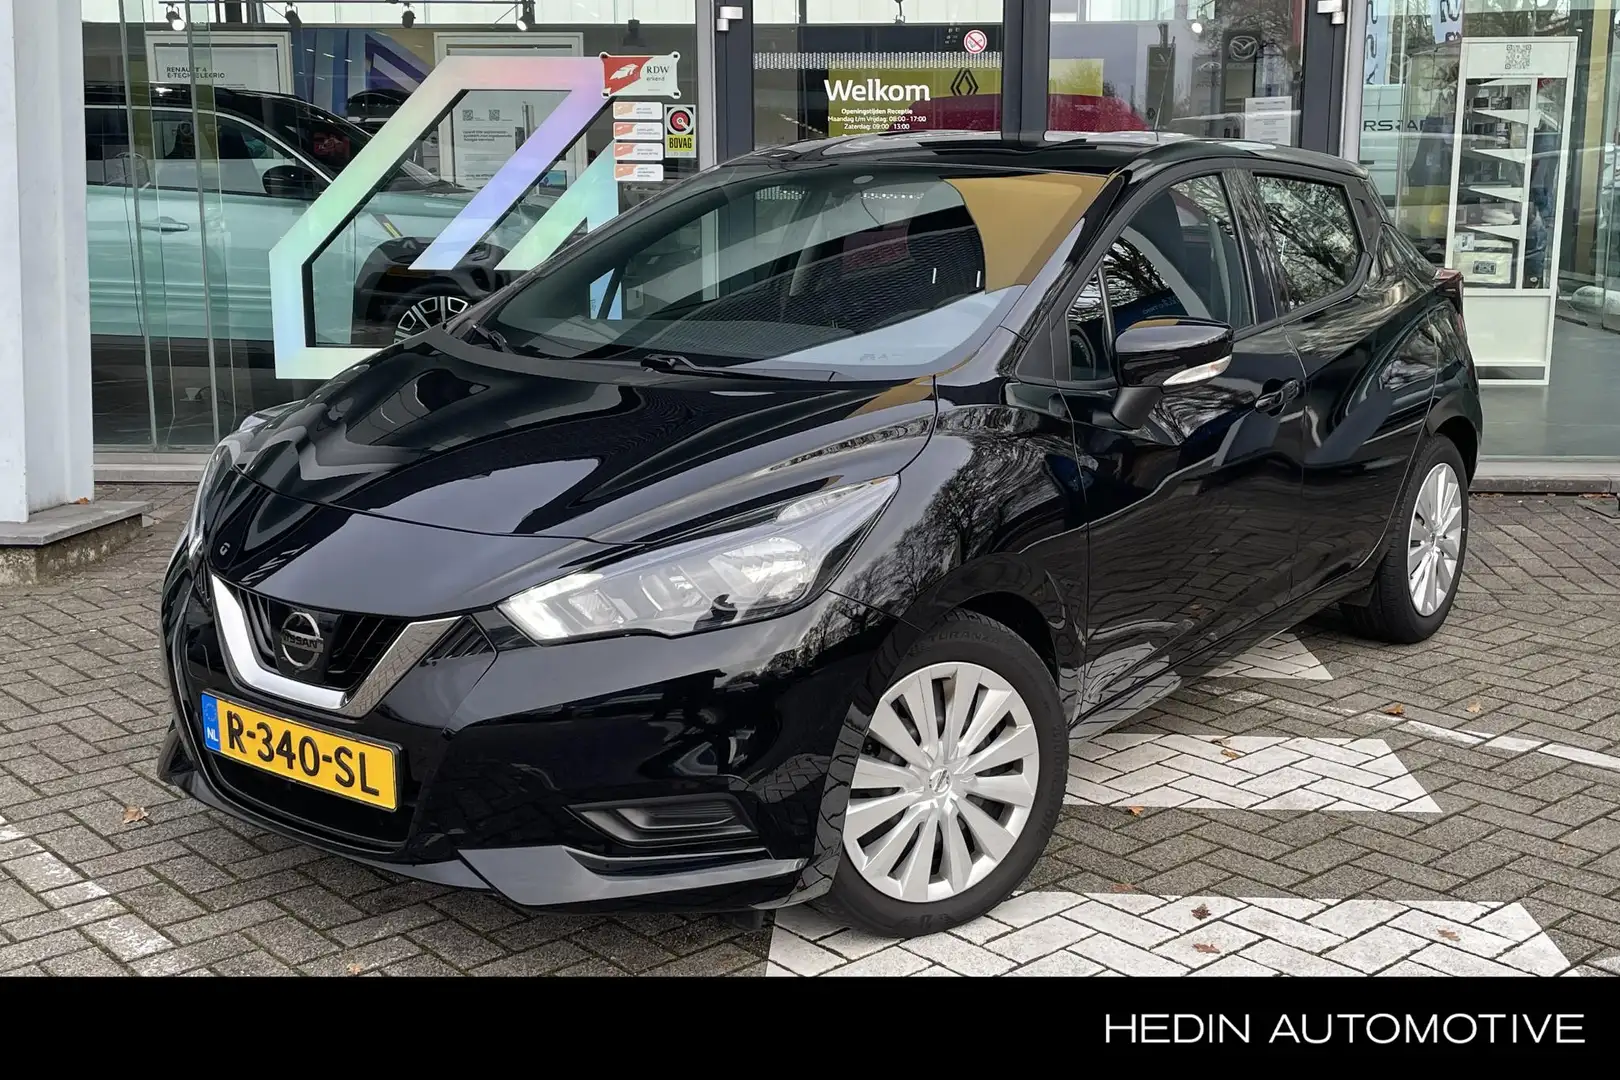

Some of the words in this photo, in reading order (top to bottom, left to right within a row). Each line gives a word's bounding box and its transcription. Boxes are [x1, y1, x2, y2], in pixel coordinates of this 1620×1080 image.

[646, 66, 669, 74] RDW
[823, 78, 931, 101] Welkom
[841, 108, 886, 116] Openingstijden
[887, 108, 913, 116] Receptie
[669, 137, 692, 149] BOVAG
[282, 630, 318, 649] NISSAN
[206, 726, 219, 742] NL
[226, 710, 380, 797] R-340-SL
